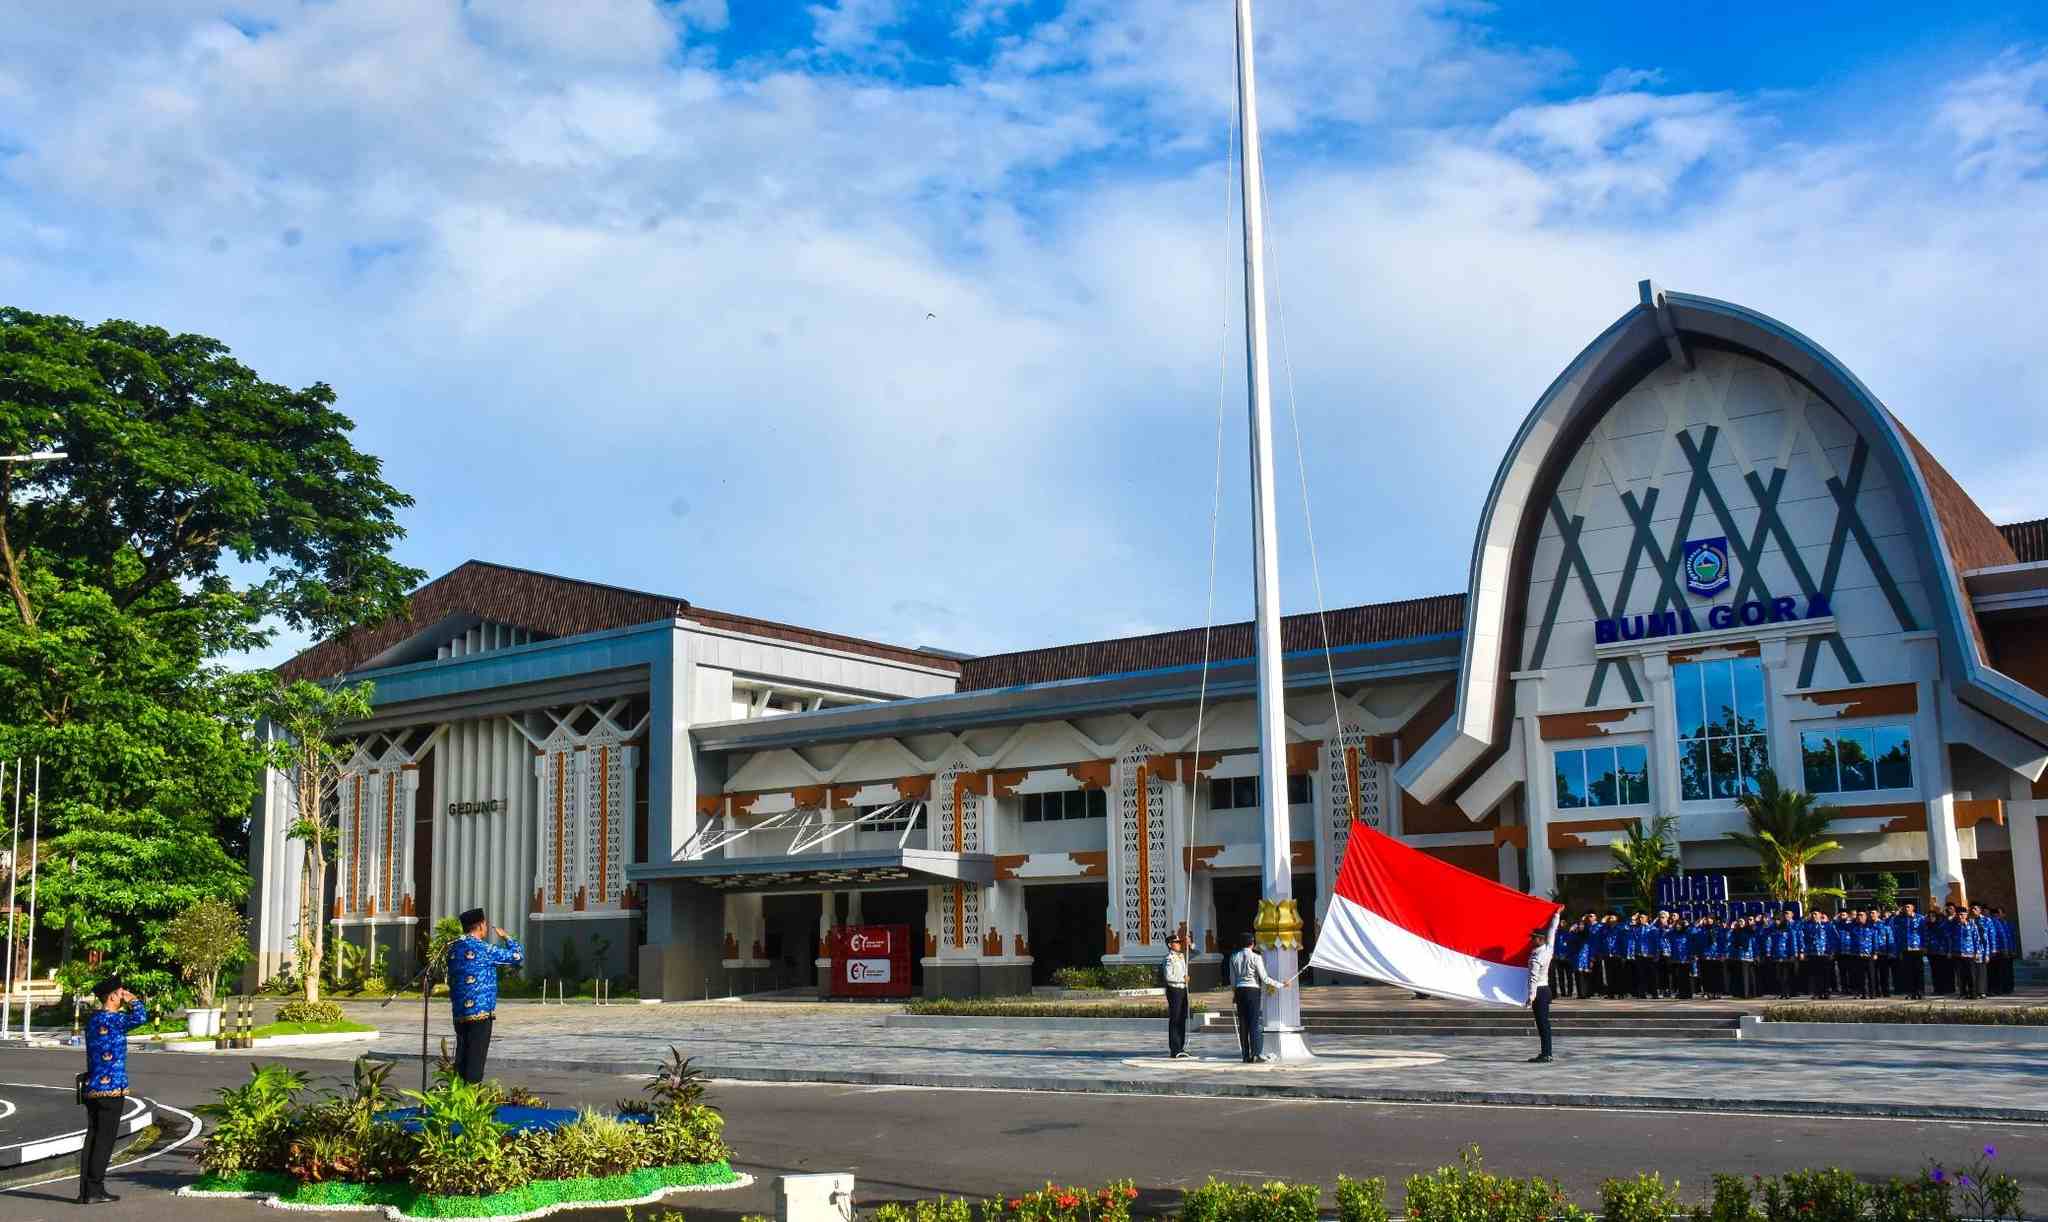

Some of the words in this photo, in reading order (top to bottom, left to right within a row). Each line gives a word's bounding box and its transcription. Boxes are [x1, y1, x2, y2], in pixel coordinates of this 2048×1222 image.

[1594, 608, 1692, 644] BUMI
[1708, 592, 1833, 630] GORA
[448, 800, 498, 816] GEDUNG
